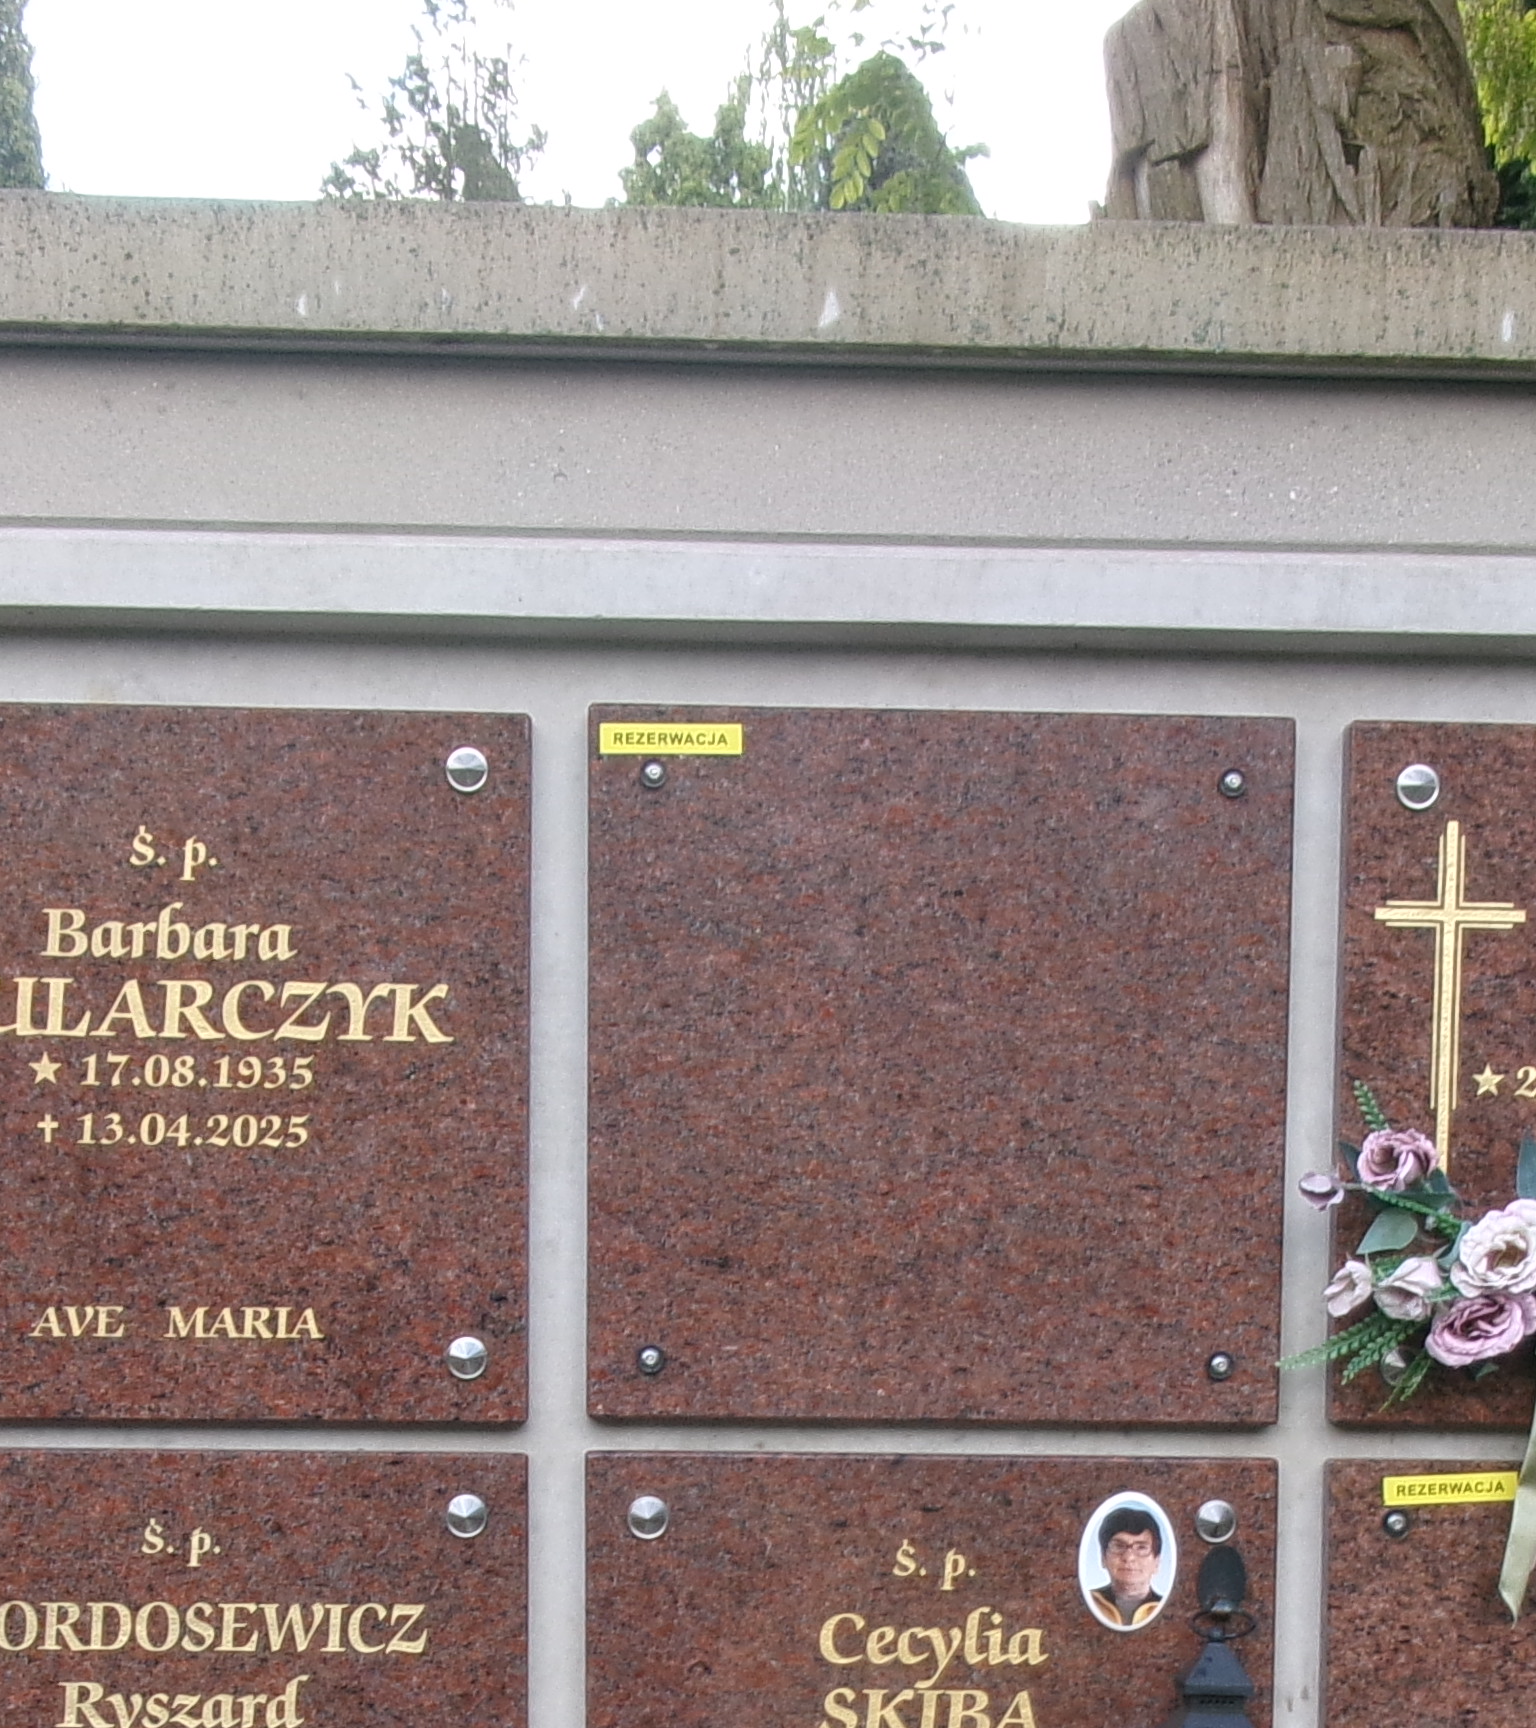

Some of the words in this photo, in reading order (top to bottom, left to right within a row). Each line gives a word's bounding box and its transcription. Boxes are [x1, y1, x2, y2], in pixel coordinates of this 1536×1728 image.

[612, 731, 729, 747] REZERWACJA
[39, 901, 298, 962] Barbara
[80, 1050, 314, 1090] 17.08.1935
[76, 1112, 310, 1148] 13.04.2025
[28, 1305, 125, 1339] AVE
[163, 1305, 325, 1339] MARIA
[1396, 1480, 1505, 1497] REZERWACJA
[819, 1606, 1049, 1688] Cecylia
